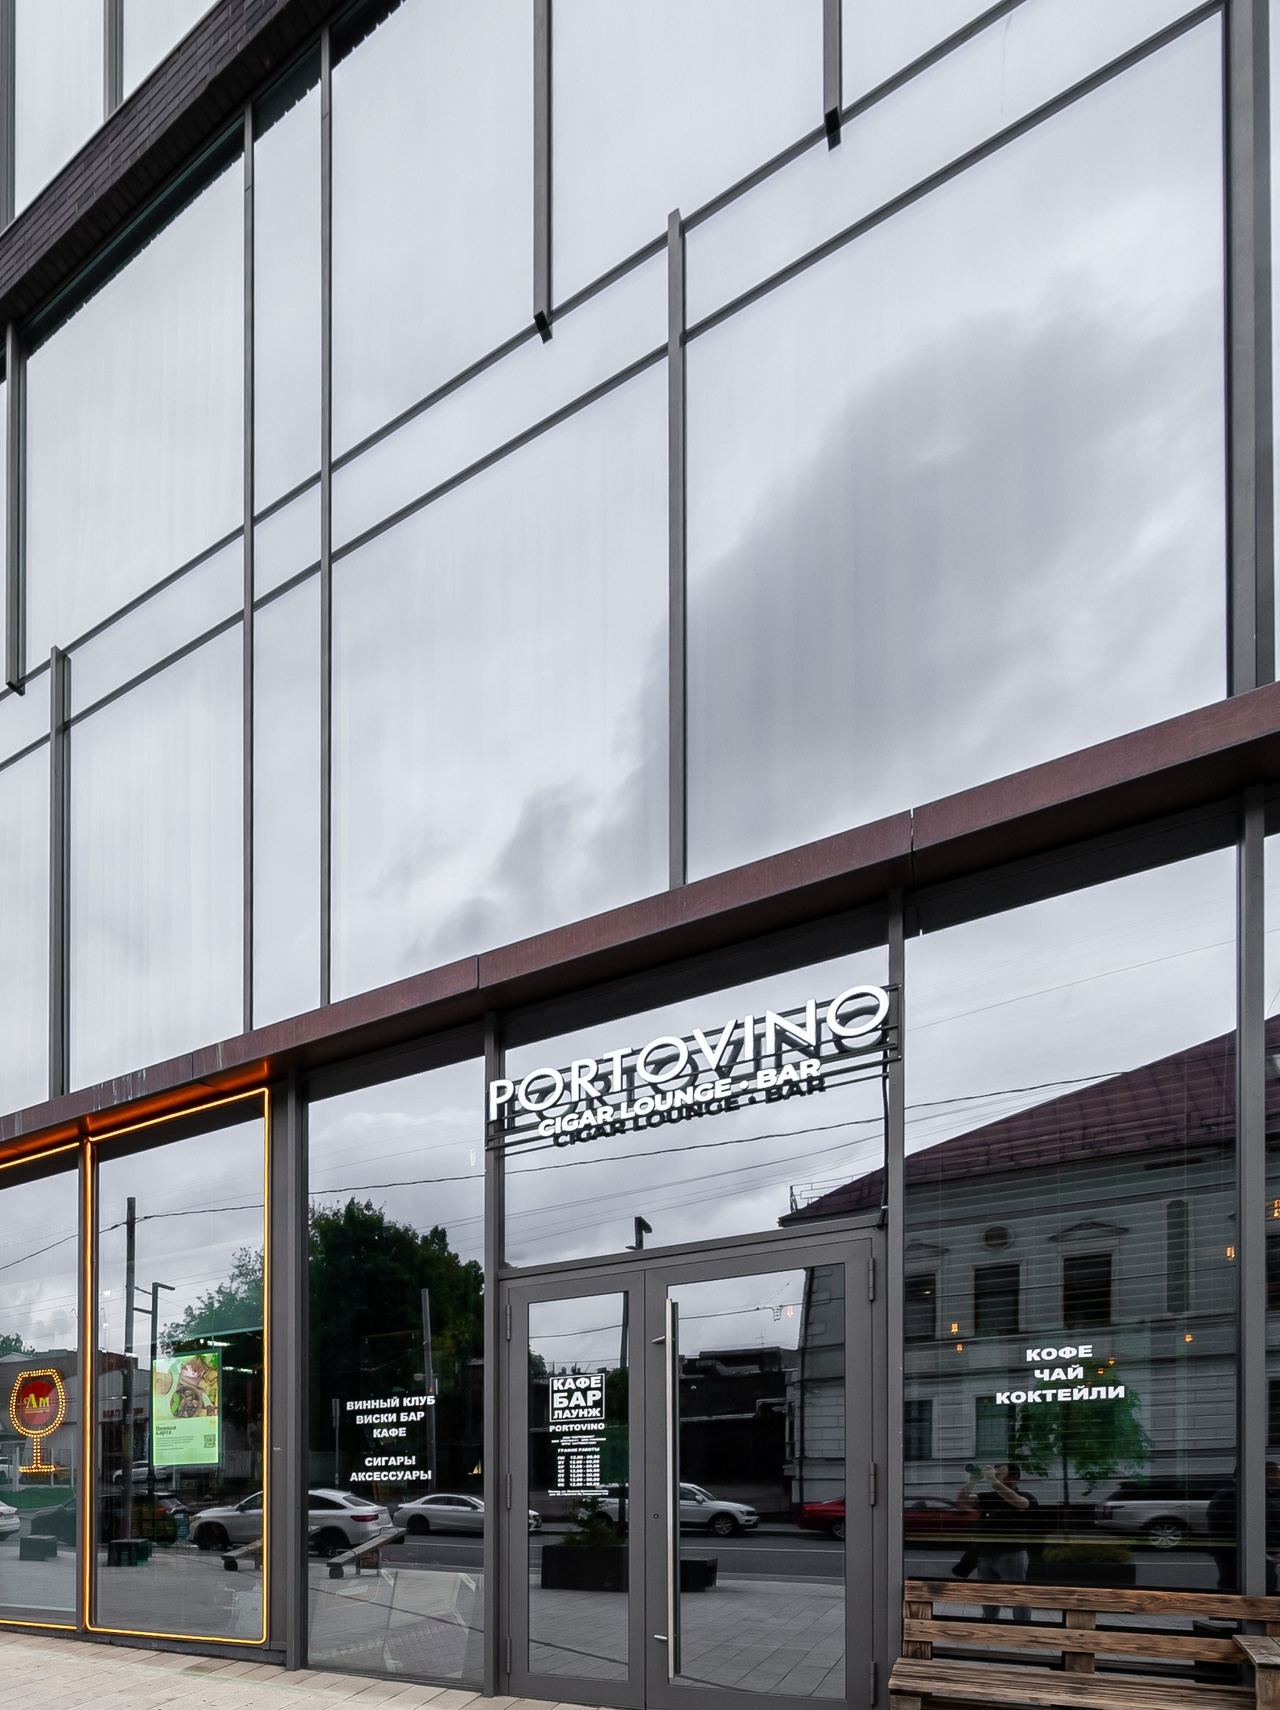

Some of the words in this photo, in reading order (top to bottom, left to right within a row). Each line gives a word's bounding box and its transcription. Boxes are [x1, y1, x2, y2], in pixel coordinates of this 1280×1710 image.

[489, 985, 890, 1121] PORTOVINO
[537, 1106, 614, 1137] CIGAR
[620, 1076, 733, 1121] LOUNGE
[756, 1058, 822, 1089] BAR
[1026, 1345, 1093, 1361] КОФЕ
[1034, 1364, 1084, 1381] ЧАЙ
[553, 1376, 601, 1390] КАФЕ
[553, 1390, 602, 1408] БАР
[996, 1385, 1125, 1405] КОКТЕЙЛИ
[346, 1396, 400, 1410] ВИННЫЙ
[402, 1395, 436, 1406] КЛУБ
[356, 1412, 397, 1424] ВИСКИ
[400, 1411, 425, 1422] БАР
[553, 1408, 601, 1419] ЛАУНЖ
[372, 1427, 407, 1438] КАФЕ
[549, 1422, 605, 1433] PORTOVINO
[364, 1456, 416, 1467] СИГАРЫ
[349, 1469, 432, 1482] АКСЕССУАРЫ
